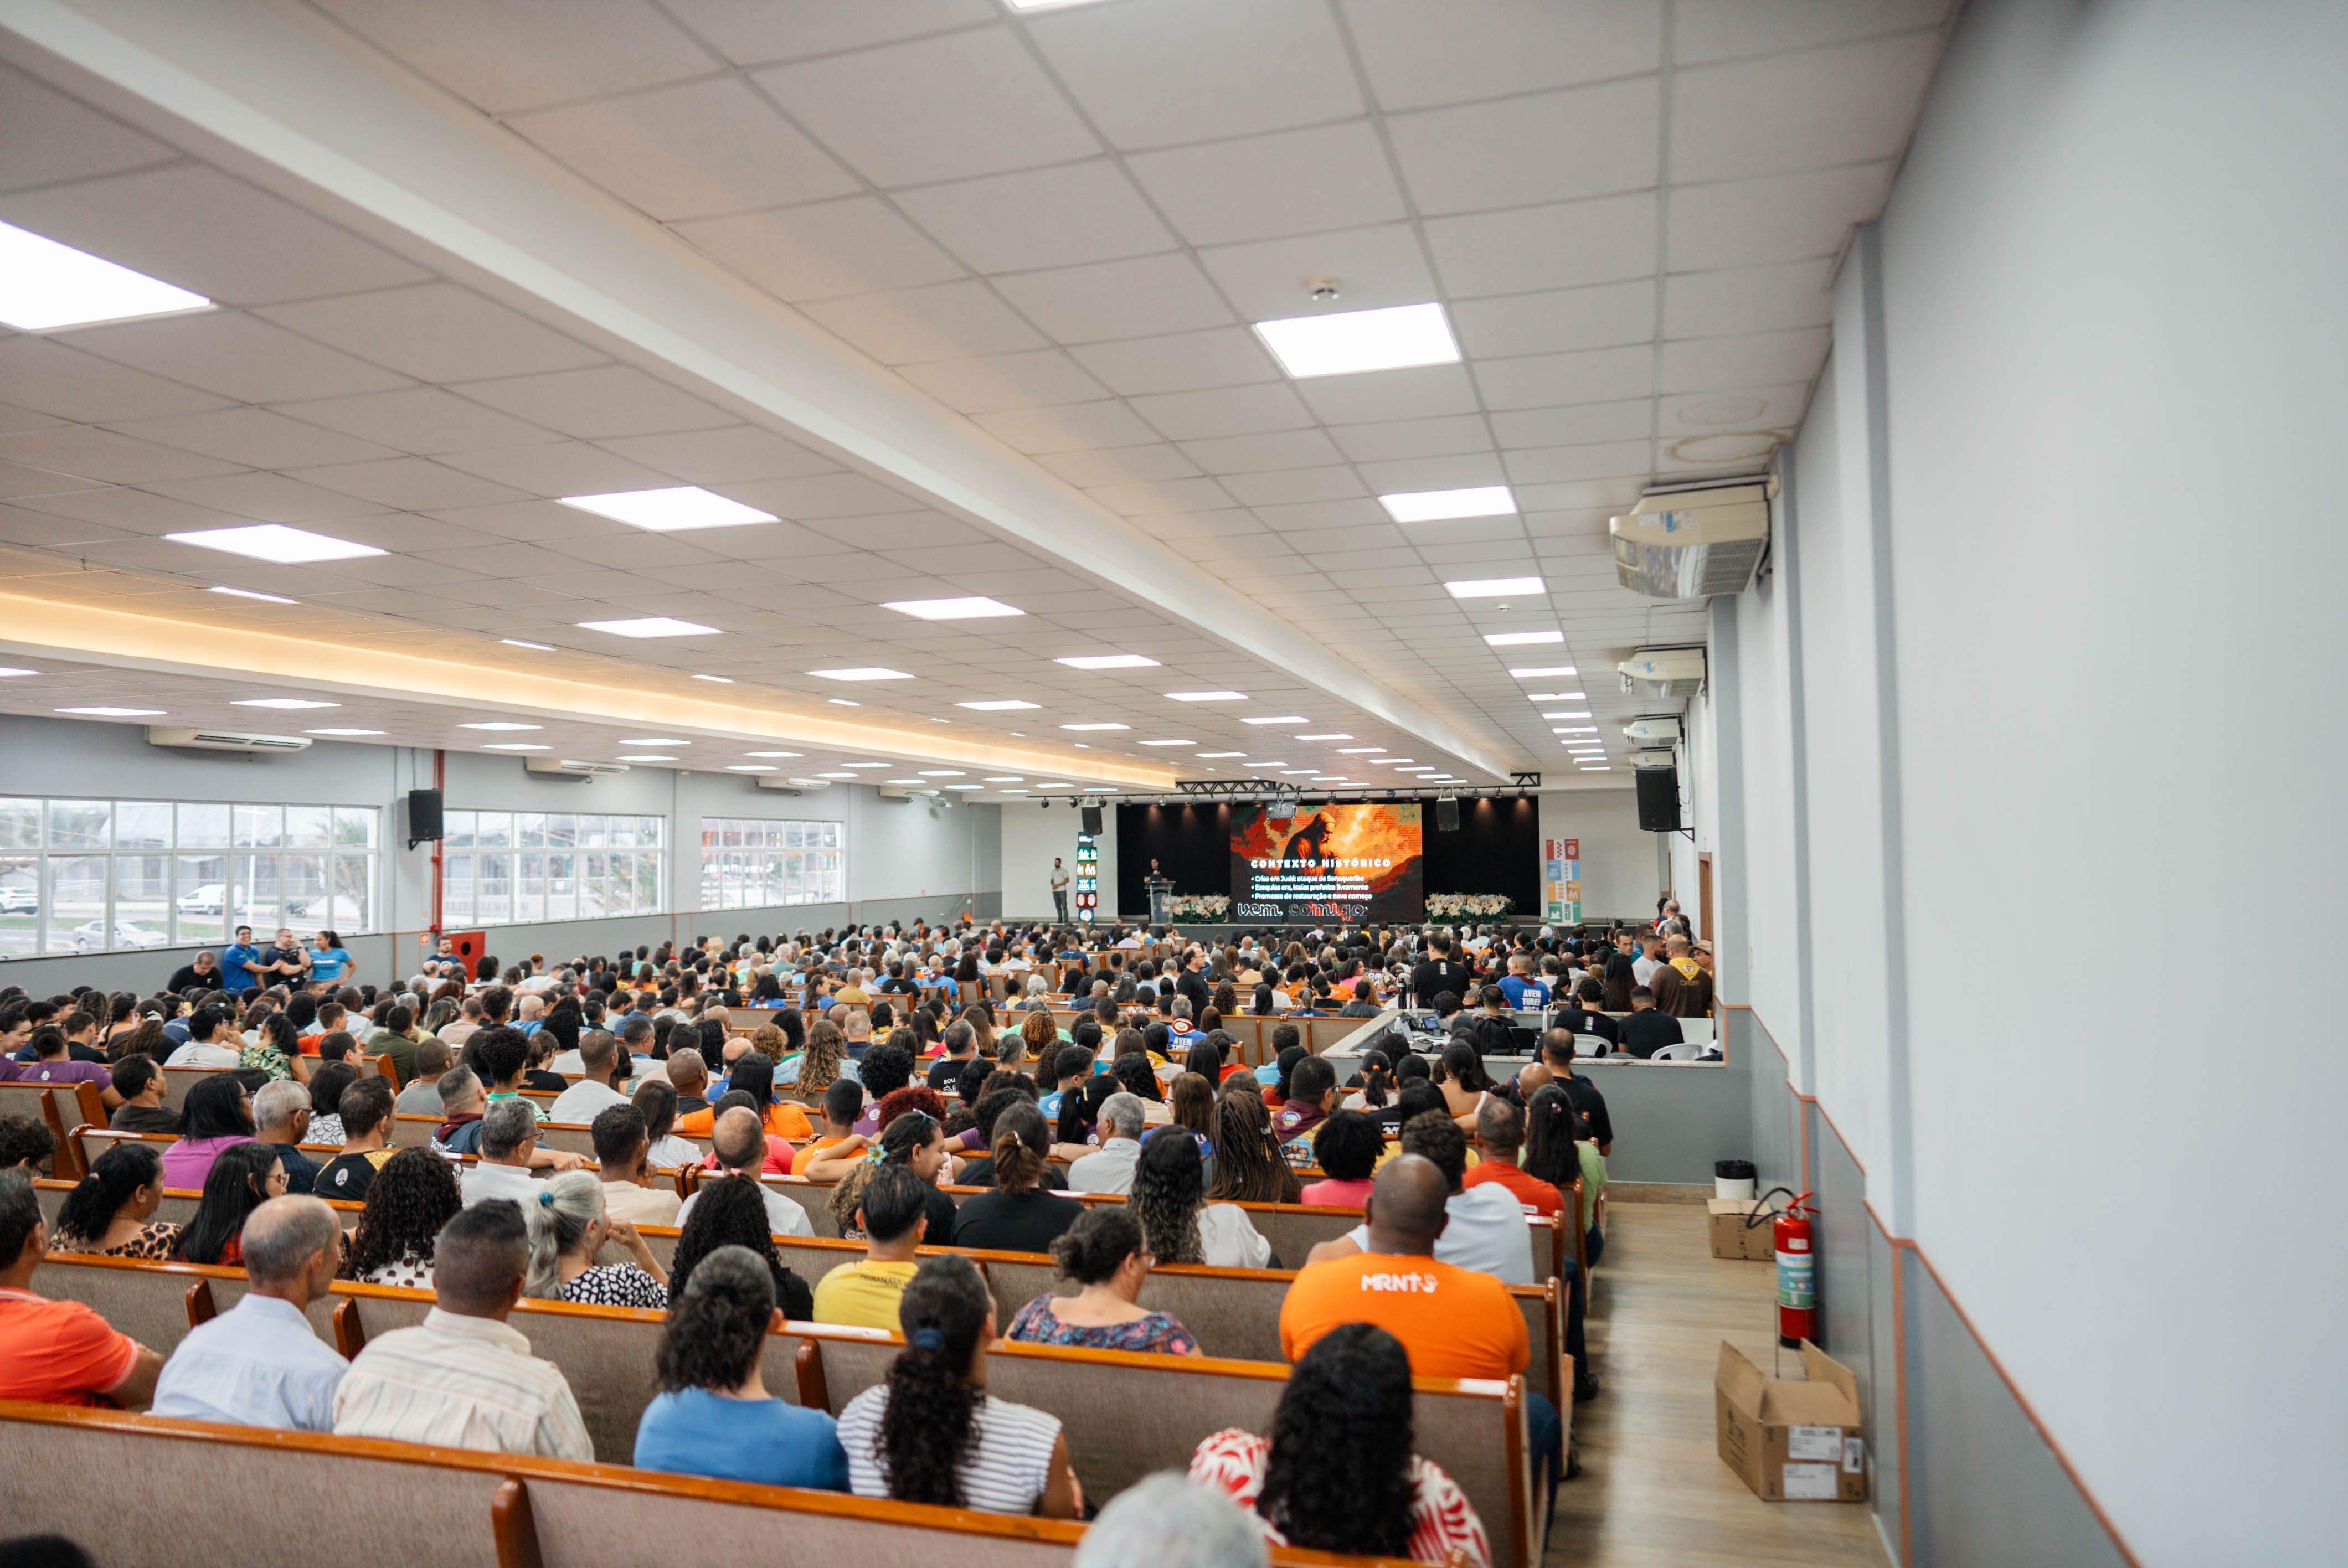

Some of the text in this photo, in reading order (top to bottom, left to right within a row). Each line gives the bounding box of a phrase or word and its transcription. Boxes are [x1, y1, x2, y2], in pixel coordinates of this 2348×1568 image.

[1250, 857, 1391, 868] CONTEXTO HISTÓRICO
[1523, 989, 1541, 998] AVEN
[1173, 1036, 1192, 1046] AVEN
